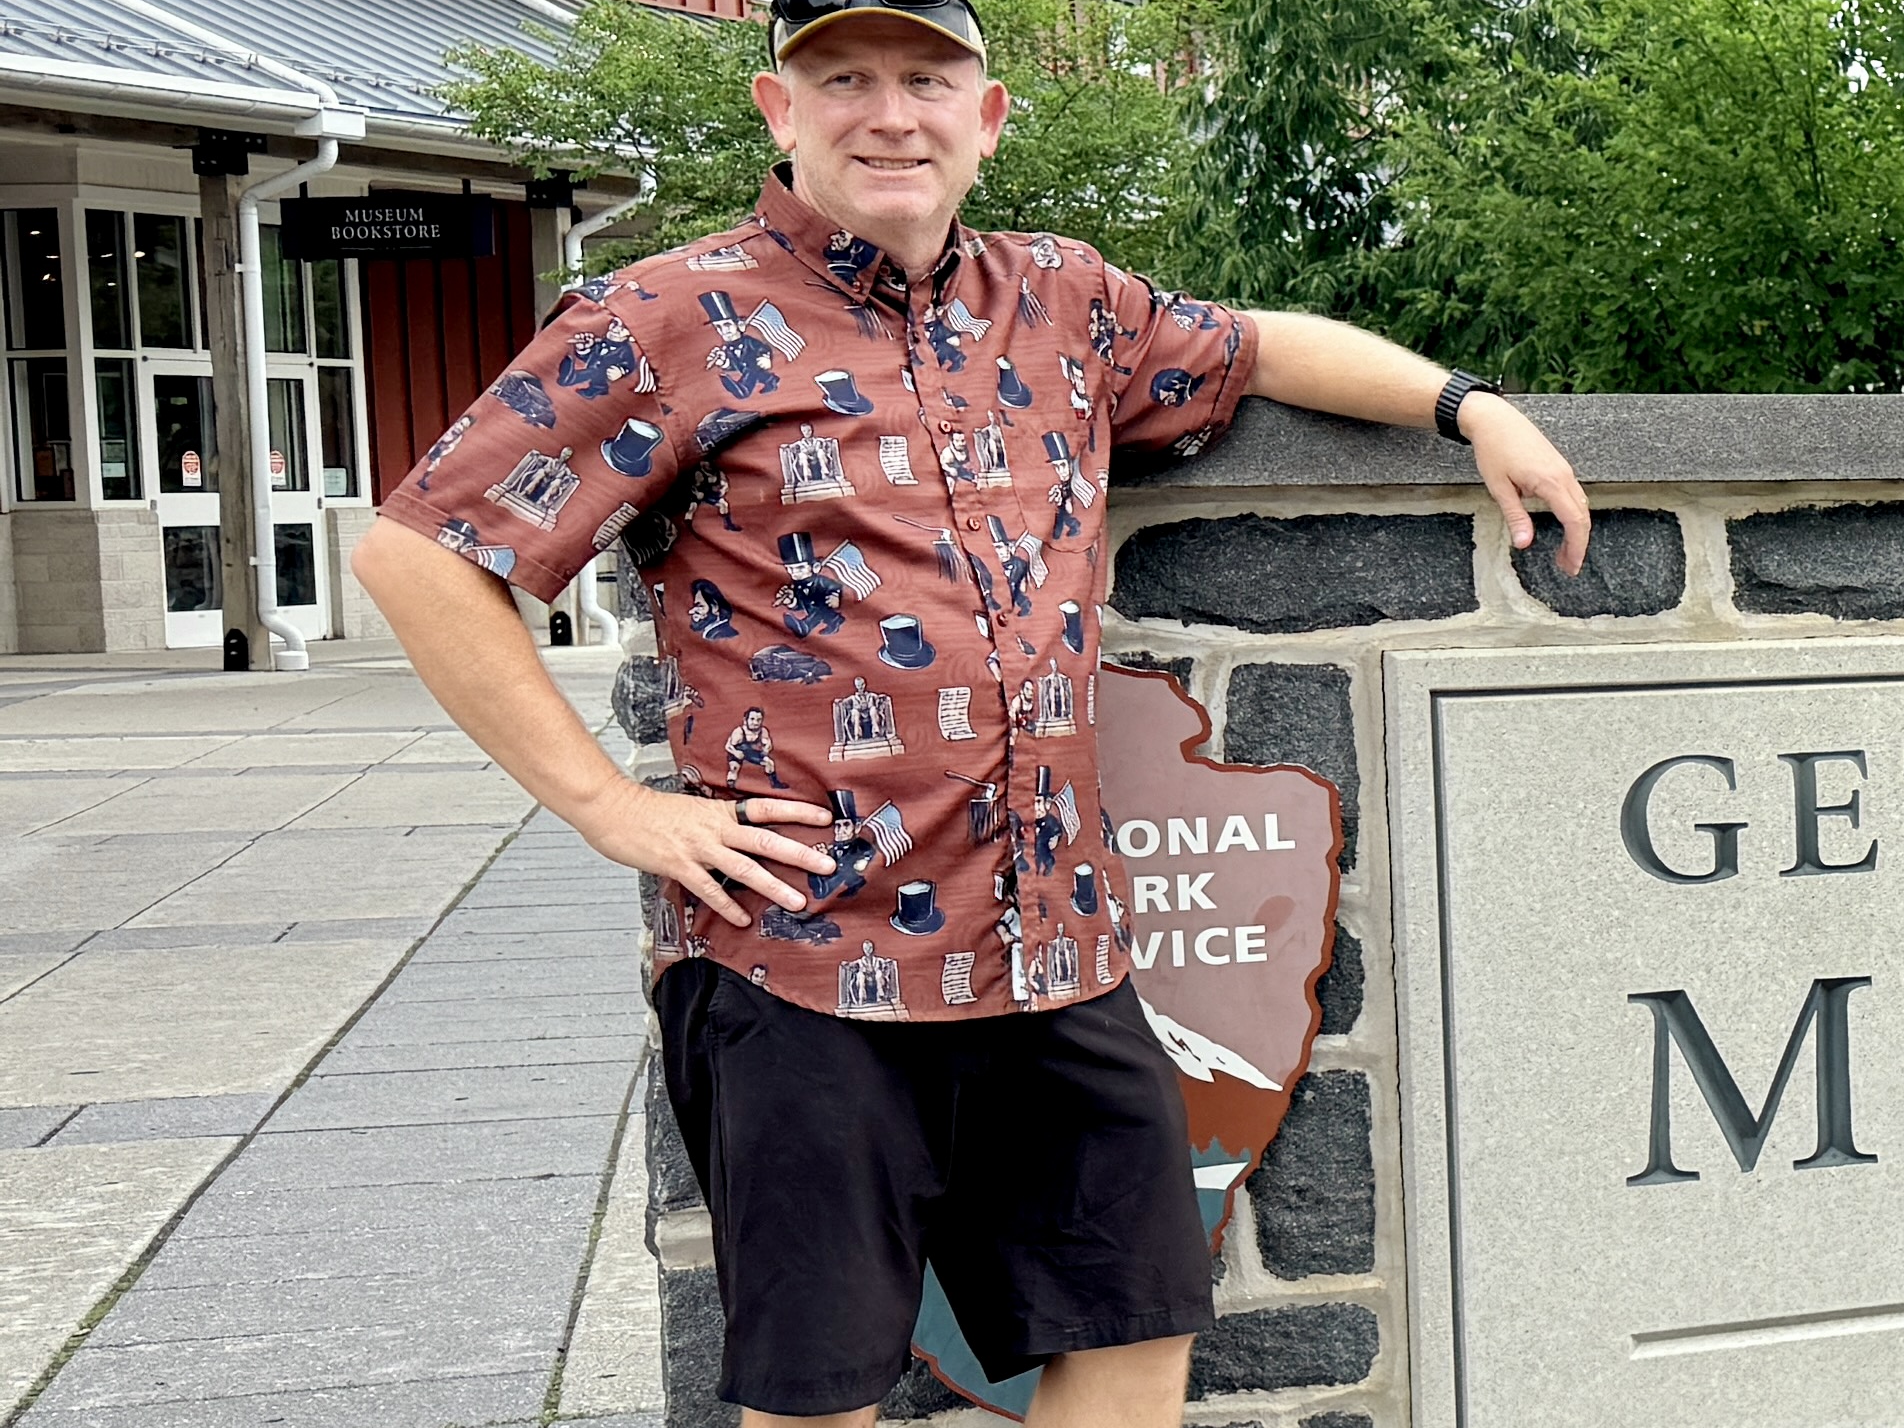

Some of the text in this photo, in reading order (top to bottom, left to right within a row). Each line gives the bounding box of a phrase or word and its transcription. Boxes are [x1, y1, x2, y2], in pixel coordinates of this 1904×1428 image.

[331, 224, 441, 240] BOOKSTORE
[345, 207, 424, 223] MUSEUM
[1116, 813, 1296, 858] ONAL
[1133, 872, 1218, 914] RK
[1130, 924, 1268, 970] VICE
